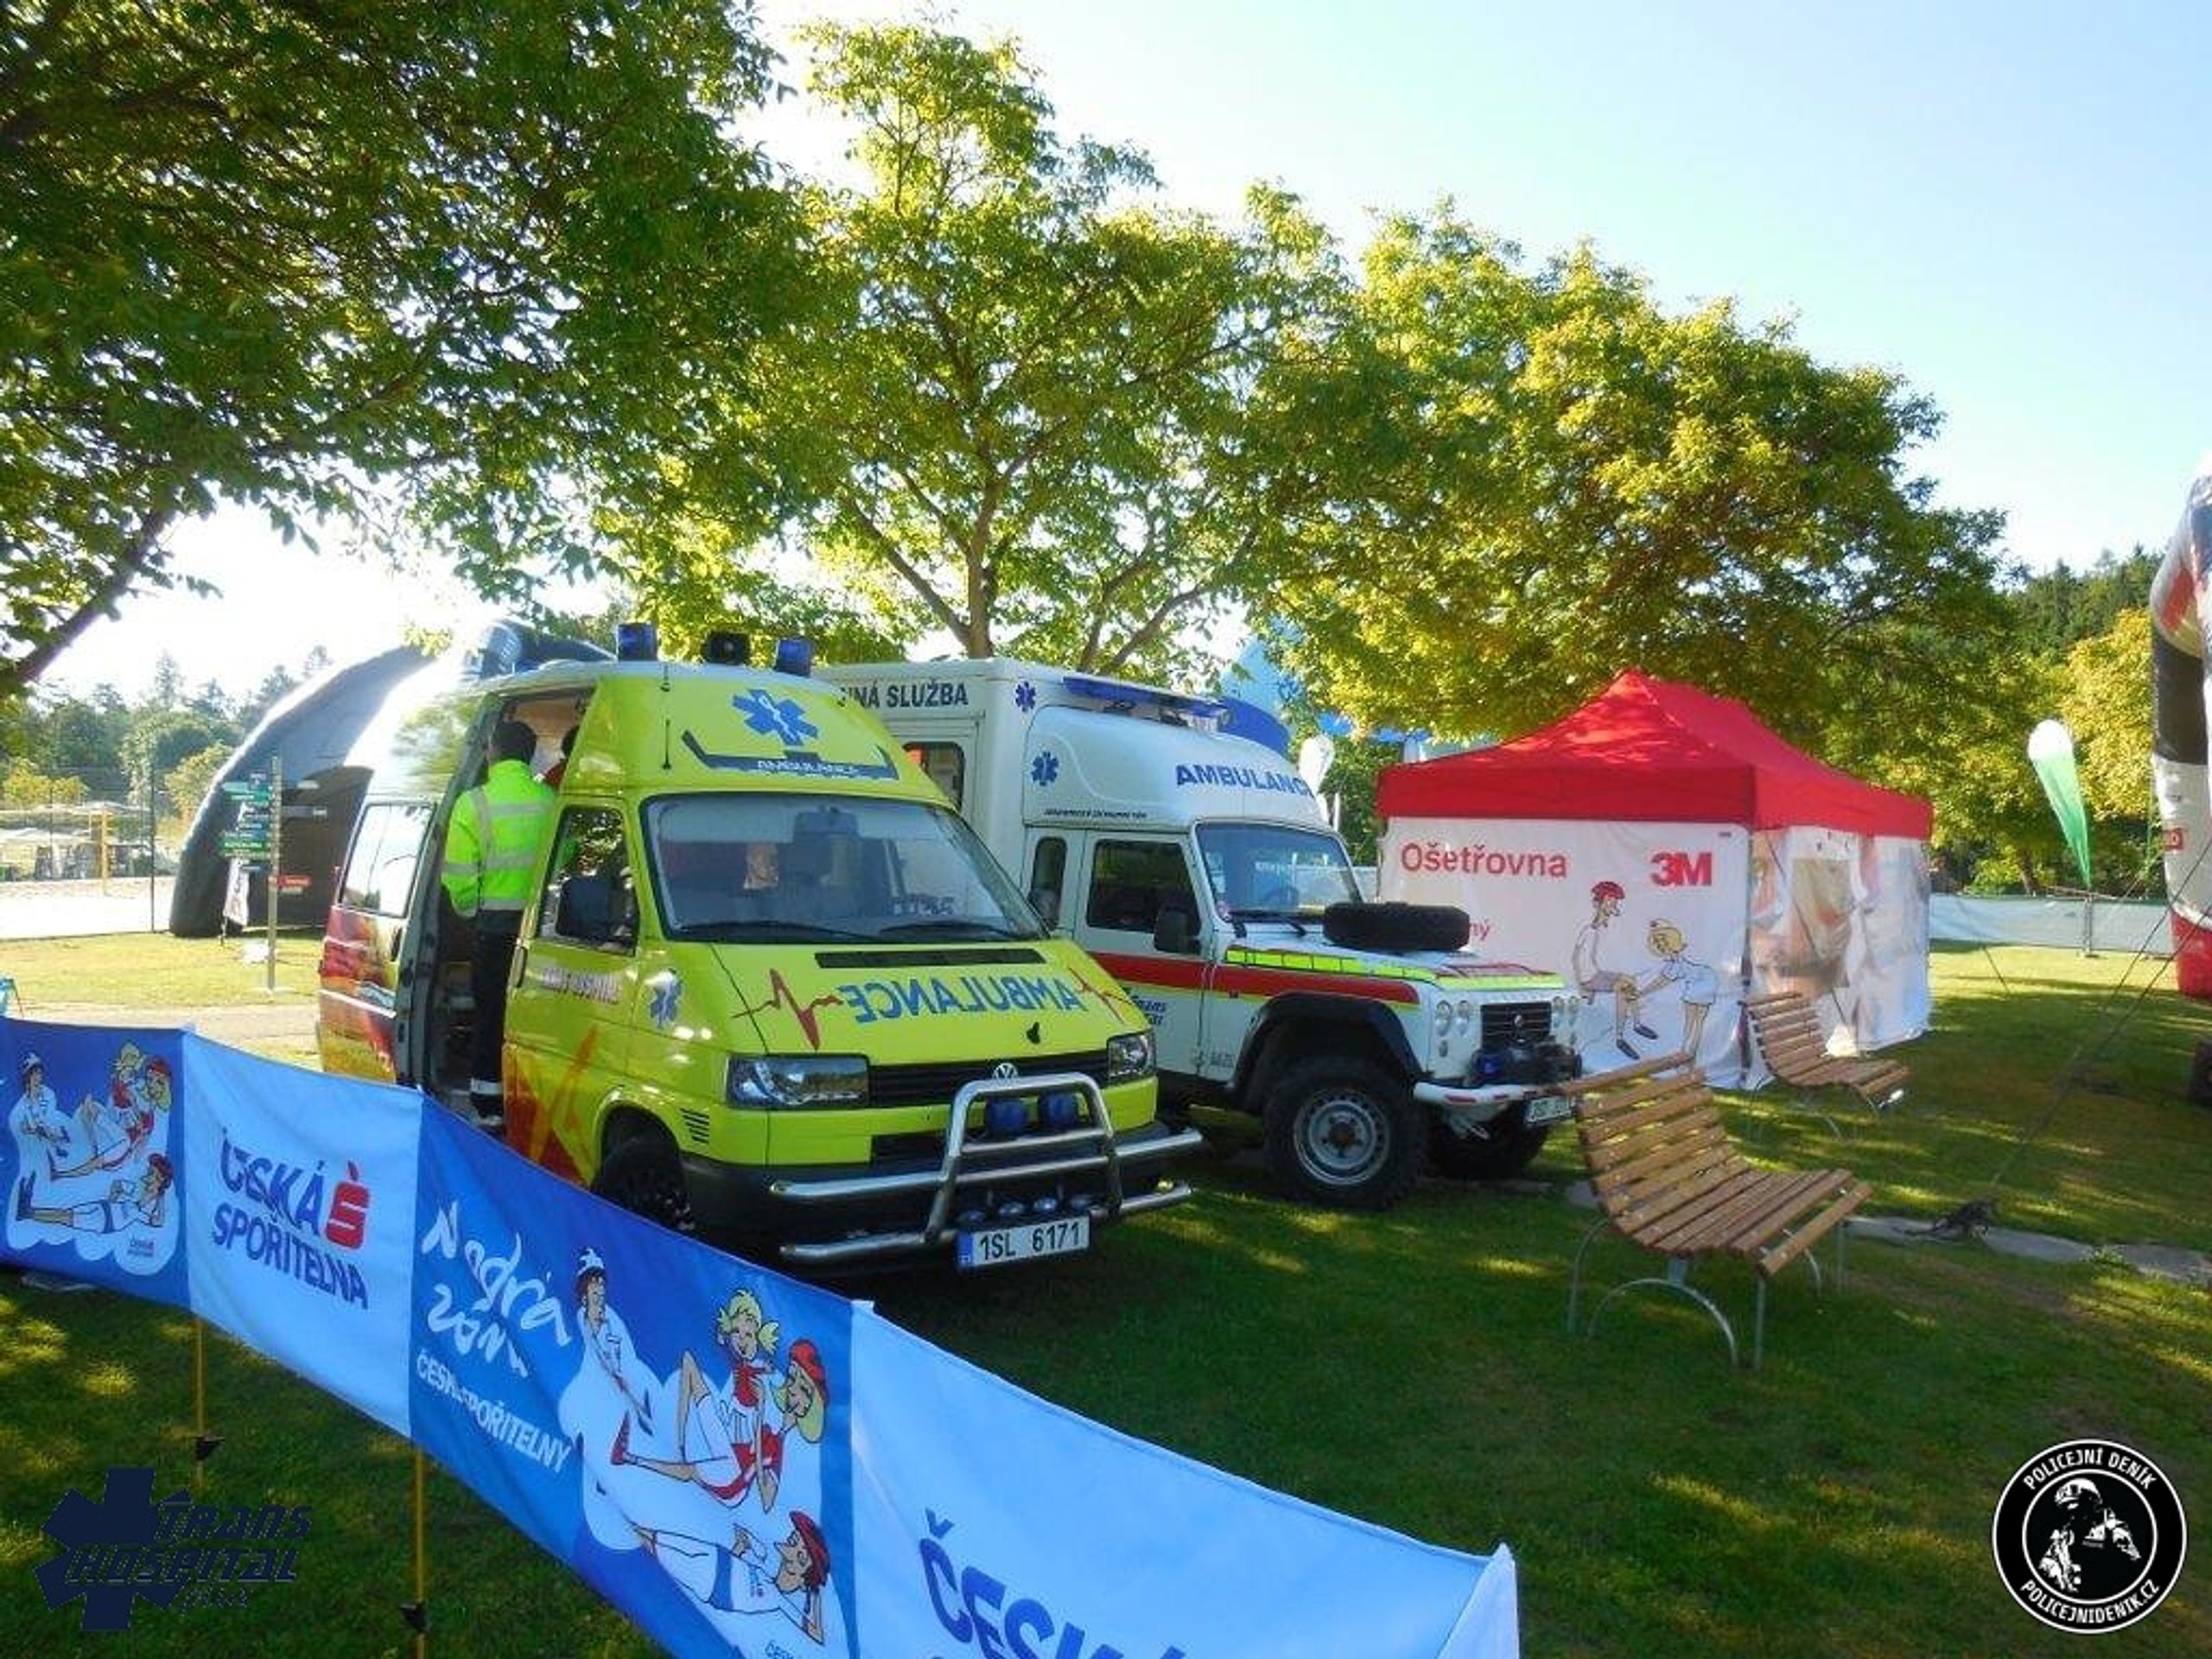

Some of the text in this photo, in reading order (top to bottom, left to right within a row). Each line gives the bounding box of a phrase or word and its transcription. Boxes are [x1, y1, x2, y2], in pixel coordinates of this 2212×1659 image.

[886, 677, 969, 708] SLUŽBA
[1175, 764, 1315, 798] AMBULANC
[1401, 842, 1568, 878] Ošetřovna
[1650, 851, 1713, 887] 3M
[1468, 917, 1491, 942] ný
[979, 1230, 1016, 1261] 1SL
[1032, 1220, 1079, 1252] 6171
